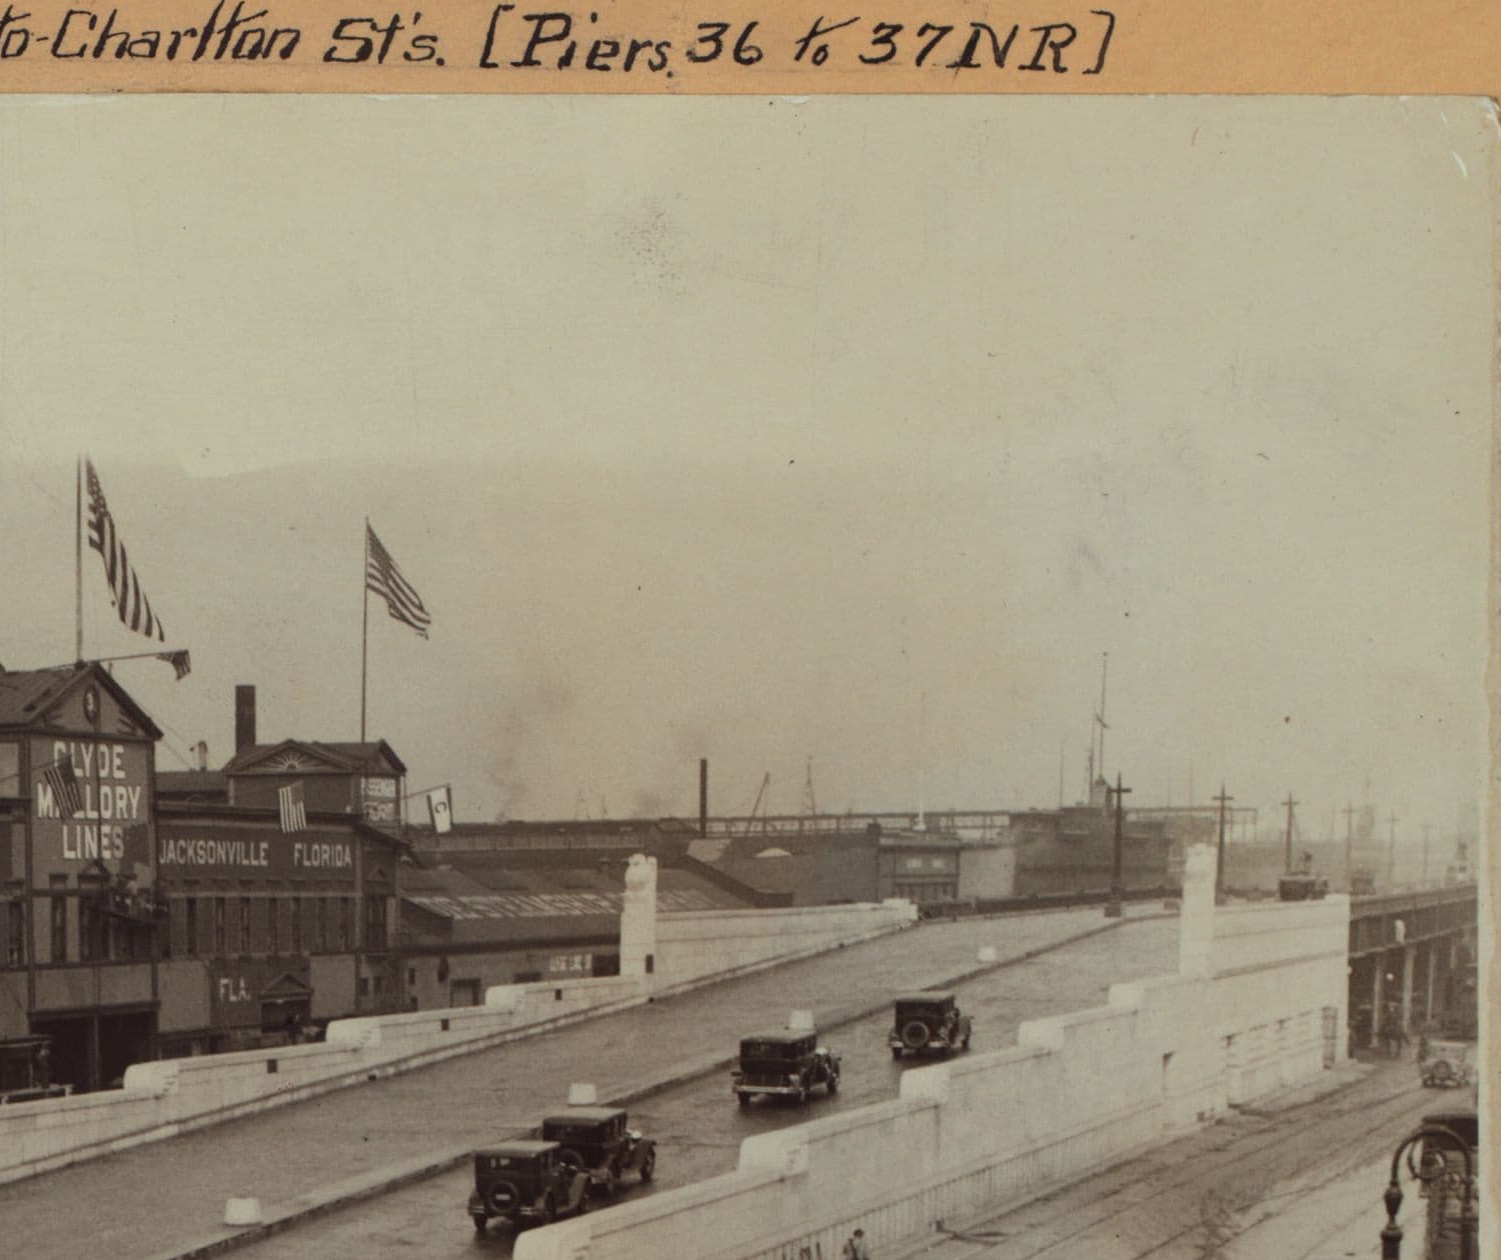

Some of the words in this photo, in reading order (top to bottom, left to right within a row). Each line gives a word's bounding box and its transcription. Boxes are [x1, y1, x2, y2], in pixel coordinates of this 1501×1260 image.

[685, 20, 764, 66] 36
[793, 15, 861, 67] to
[37, 782, 141, 819] MLORY
[62, 824, 124, 860] LINES
[159, 839, 269, 867] JACKSONVILLE
[293, 842, 352, 868] FLORIDA
